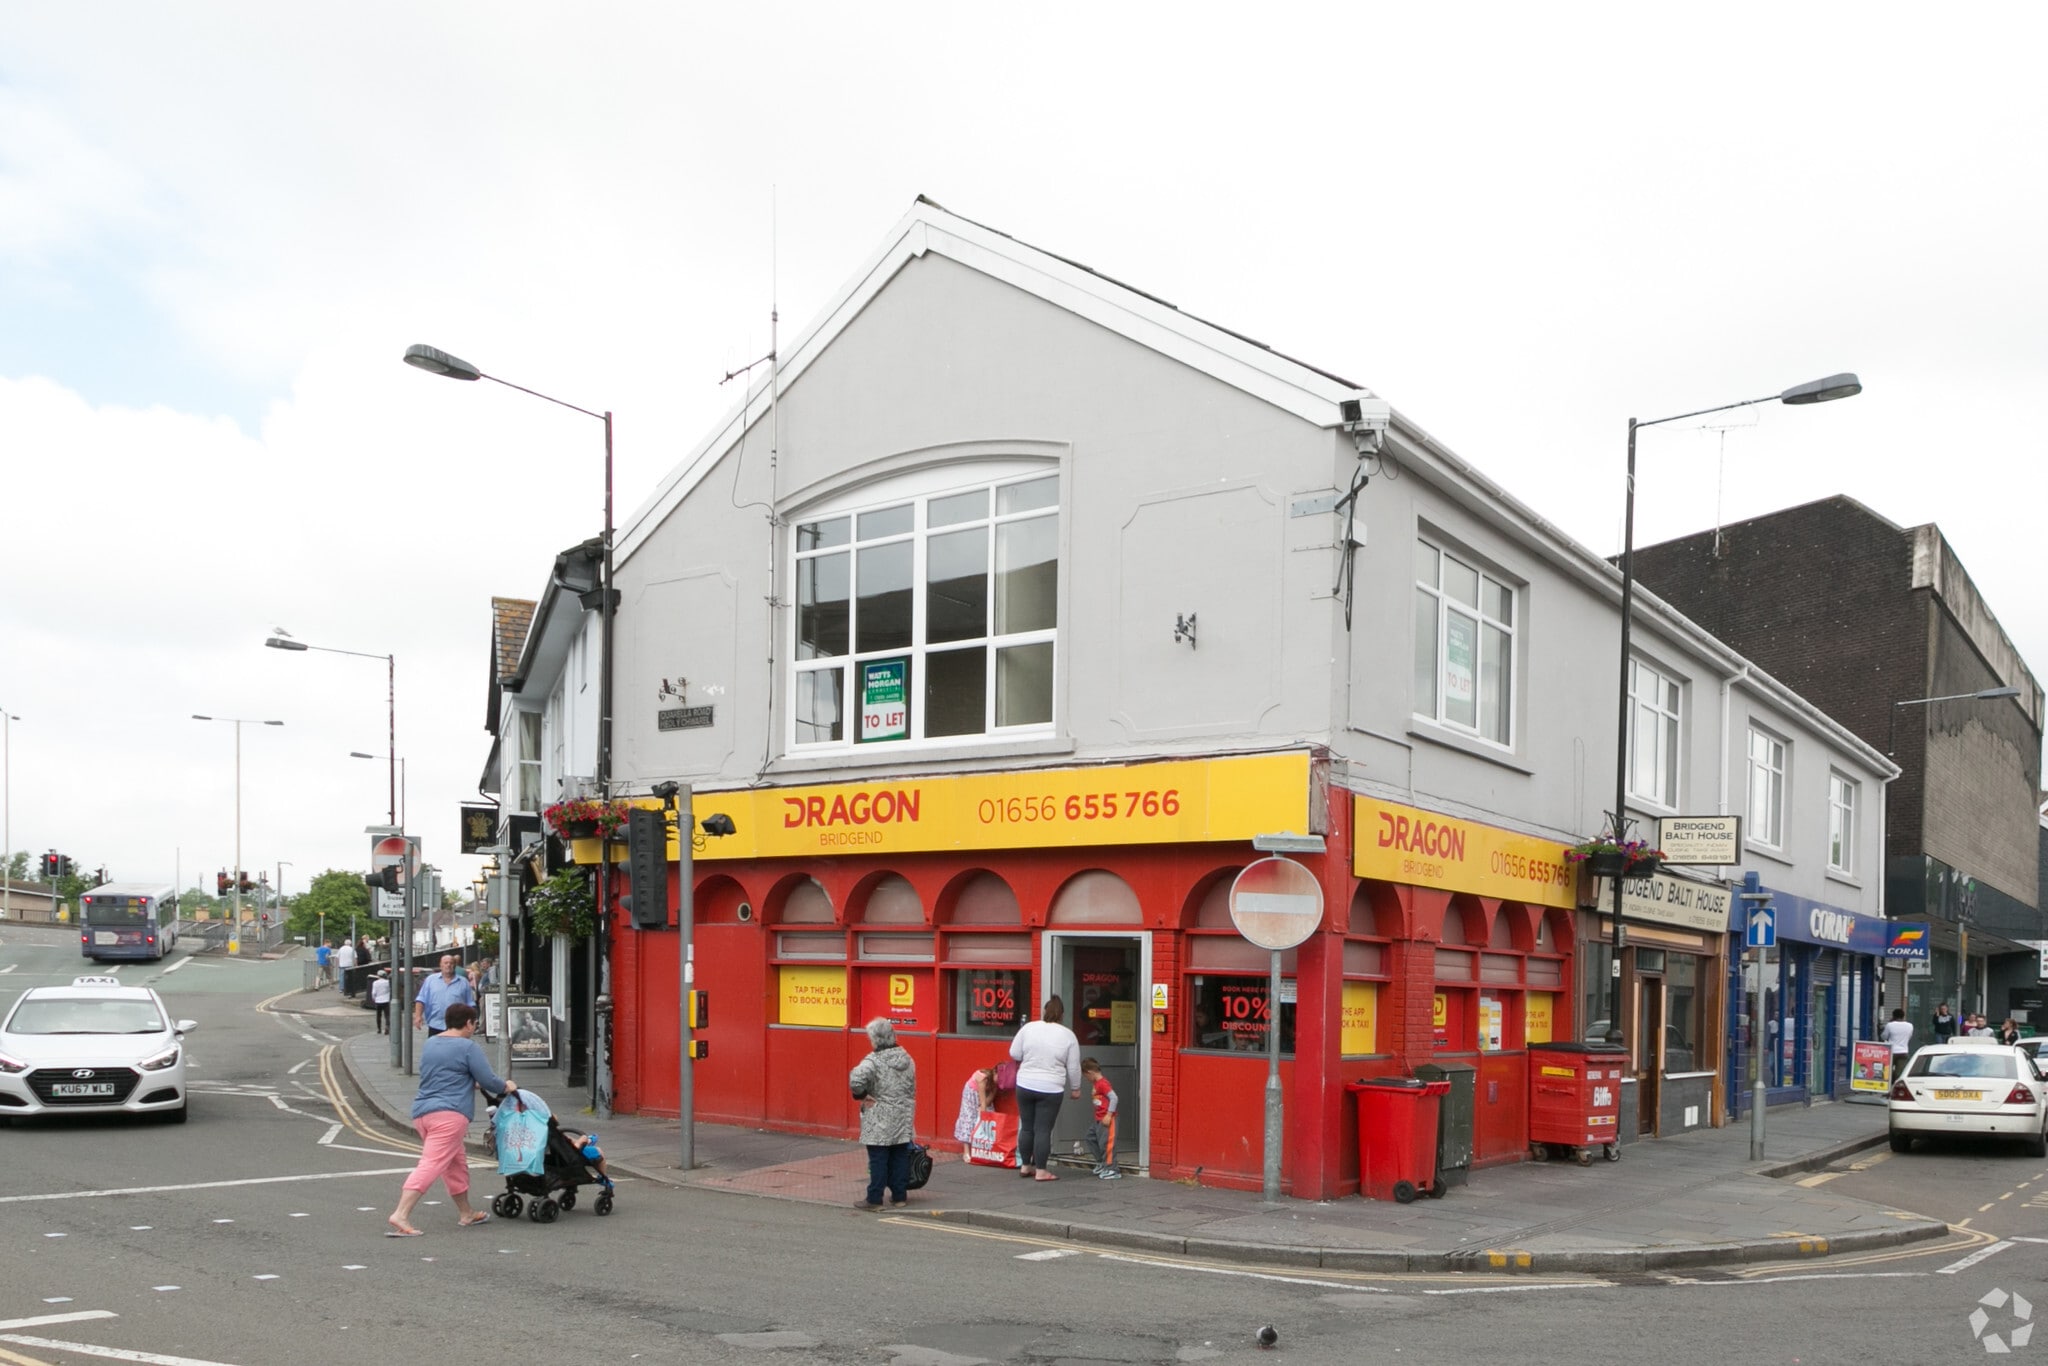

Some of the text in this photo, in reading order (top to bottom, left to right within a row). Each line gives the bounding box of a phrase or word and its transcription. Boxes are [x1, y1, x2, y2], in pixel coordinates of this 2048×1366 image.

[868, 671, 891, 680] WATTS
[1448, 672, 1470, 693] TO LET
[868, 679, 901, 689] MORGAN
[864, 712, 904, 728] TO LET
[784, 789, 920, 828] DRAGON
[978, 789, 1180, 824] 01656 655 766
[1673, 822, 1726, 831] BRIDGEND
[820, 831, 882, 846] BRIDGEND
[1378, 811, 1465, 862] DRAGON
[1665, 832, 1734, 840] BALTI HOUSE
[1403, 859, 1444, 879] BRIDGEND
[1491, 851, 1570, 887] 01656 655 766
[1667, 882, 1693, 908] BALTI
[1696, 889, 1725, 913] HOUSE
[1810, 908, 1849, 944] CORAL
[1887, 947, 1924, 956] CORAL
[795, 986, 842, 995] TAP THE APP
[788, 996, 798, 1004] TO
[800, 997, 821, 1005] BOOK
[832, 998, 846, 1006] TAX
[973, 988, 1015, 1009] 10%
[973, 1011, 1014, 1020] DISCOUNT
[1222, 996, 1272, 1020] 10%
[60, 1084, 113, 1095] KU67 WLR
[971, 1147, 1005, 1162] BARGAINS
